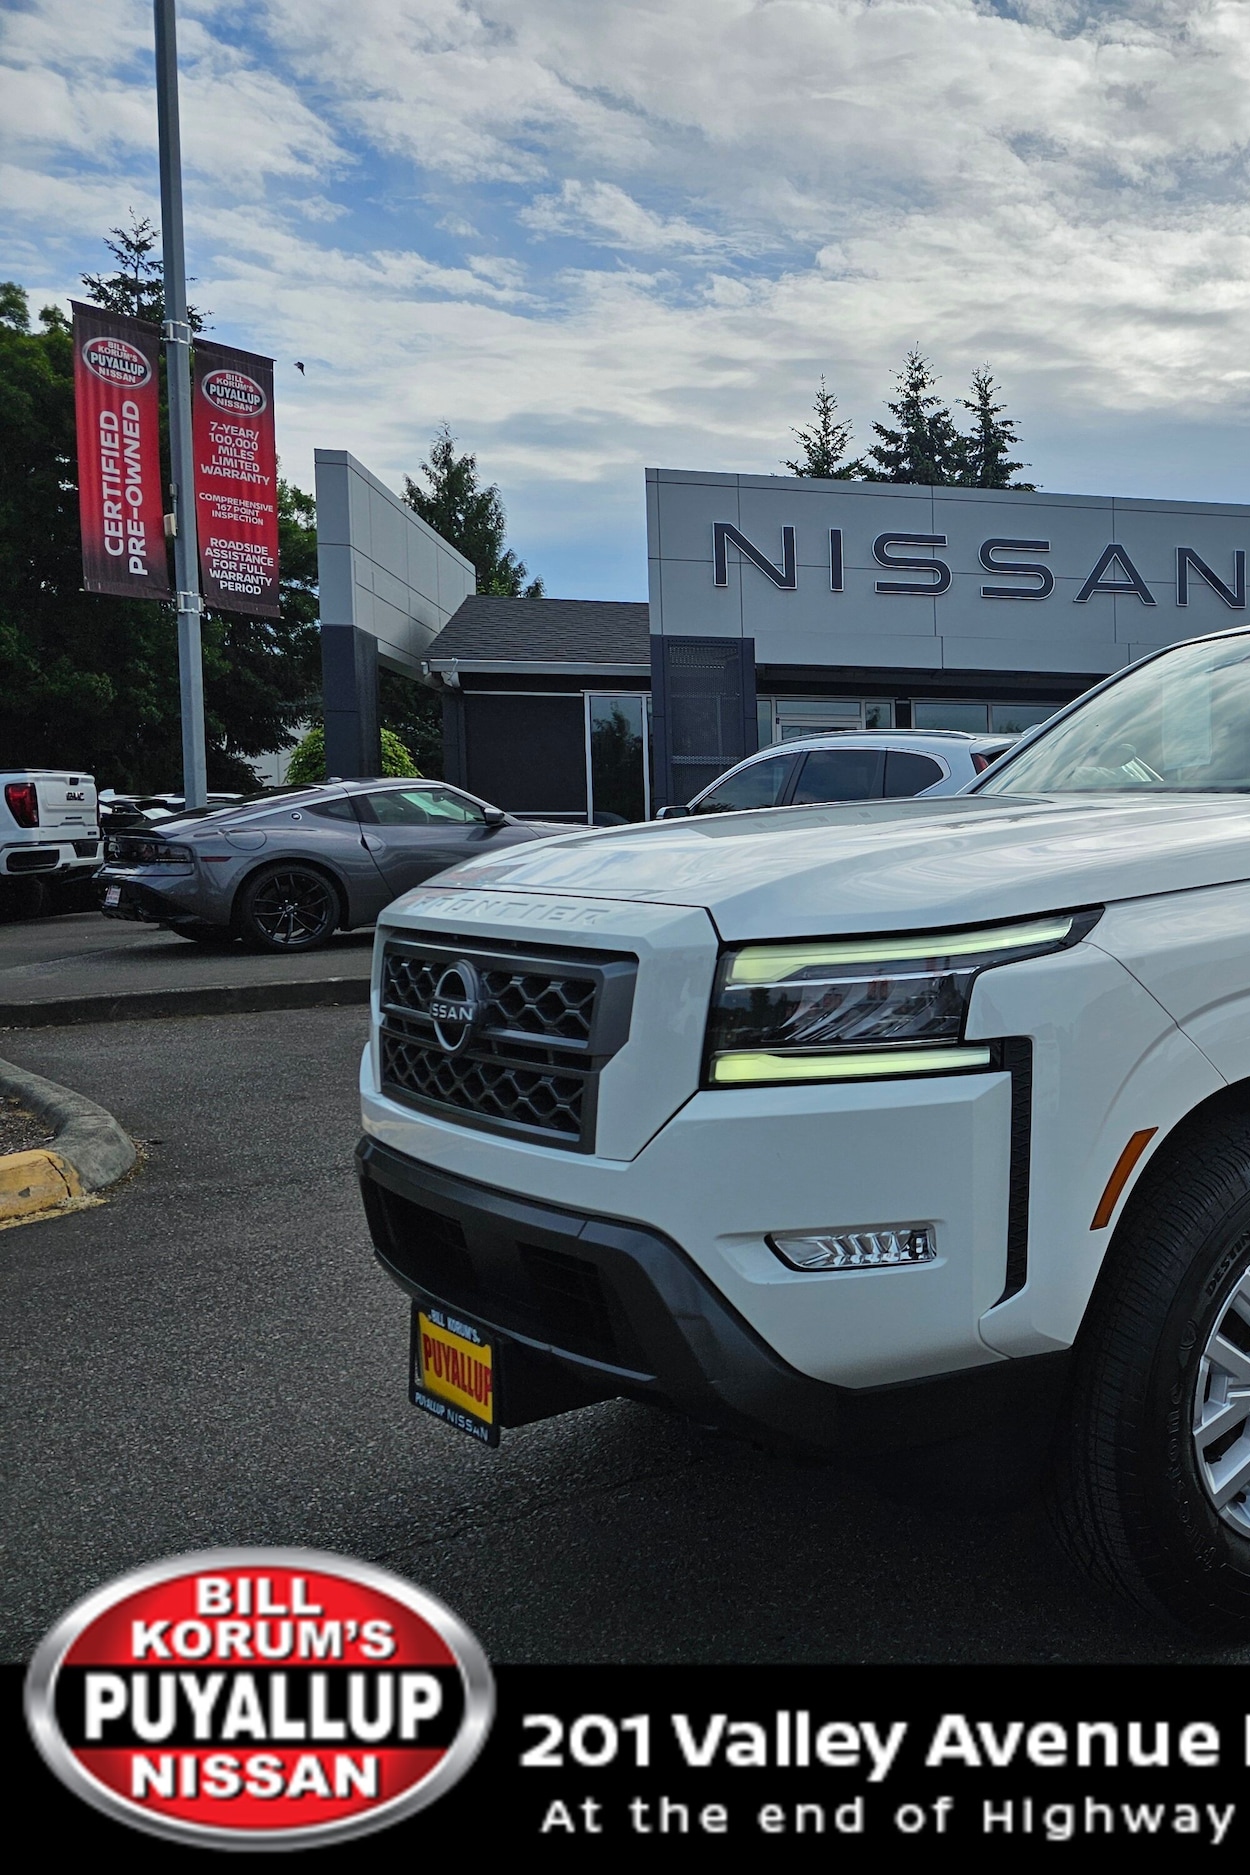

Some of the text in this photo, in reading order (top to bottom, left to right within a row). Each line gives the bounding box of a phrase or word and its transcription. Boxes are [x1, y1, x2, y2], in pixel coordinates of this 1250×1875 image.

[98, 345, 138, 363] KORUM'S
[107, 341, 127, 353] BILL
[90, 353, 145, 377] PUYALLUP
[98, 366, 136, 384] NISSAN
[225, 373, 244, 384] BILL
[216, 377, 254, 393] KORUM'S
[209, 383, 261, 406] PUYALLUP
[216, 397, 253, 412] NISSAN
[209, 421, 260, 441] 7-YEAR/
[209, 433, 259, 451] 100,000
[218, 446, 255, 461] MILES
[211, 455, 260, 473] LIMITED
[99, 410, 124, 557] CERTIFIED
[201, 464, 270, 486] WARRANTY
[122, 400, 148, 576] PRE-OWNED
[199, 492, 274, 513] COMPREHENSIVE
[216, 503, 260, 517] 167 POINT
[211, 510, 264, 526] INSPECTION
[210, 537, 268, 556] ROADSIDE
[205, 547, 274, 567] ASSISTANCE
[712, 520, 1247, 610] NISSAN
[212, 558, 266, 576] FOR FULL
[209, 569, 273, 587] WARRANTY
[219, 580, 262, 595] PERIOD
[432, 1003, 473, 1021] SSAN
[422, 1333, 493, 1408] PUYALLUP
[446, 1408, 489, 1442] NISSAN
